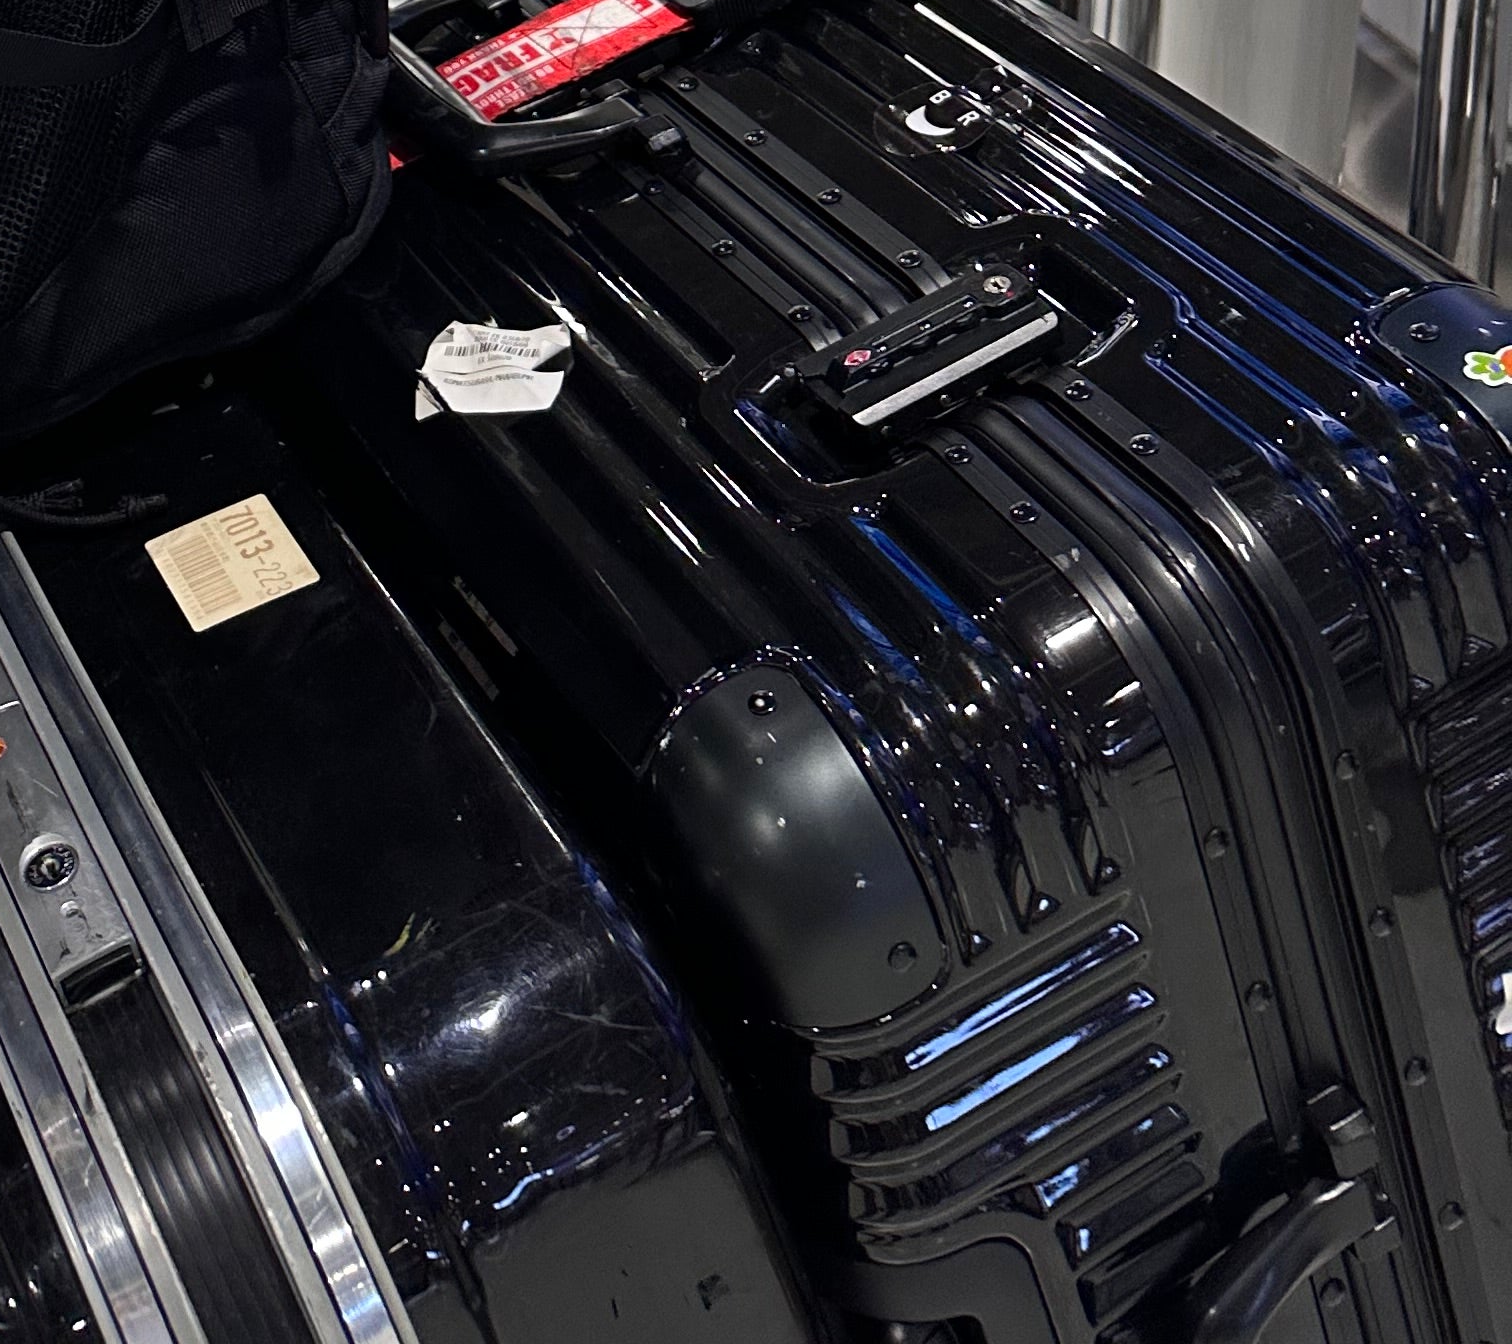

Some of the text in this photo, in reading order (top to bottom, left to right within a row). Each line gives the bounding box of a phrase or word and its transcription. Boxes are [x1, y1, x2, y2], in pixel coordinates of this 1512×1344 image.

[451, 41, 543, 96] FRAG
[928, 89, 981, 127] B R
